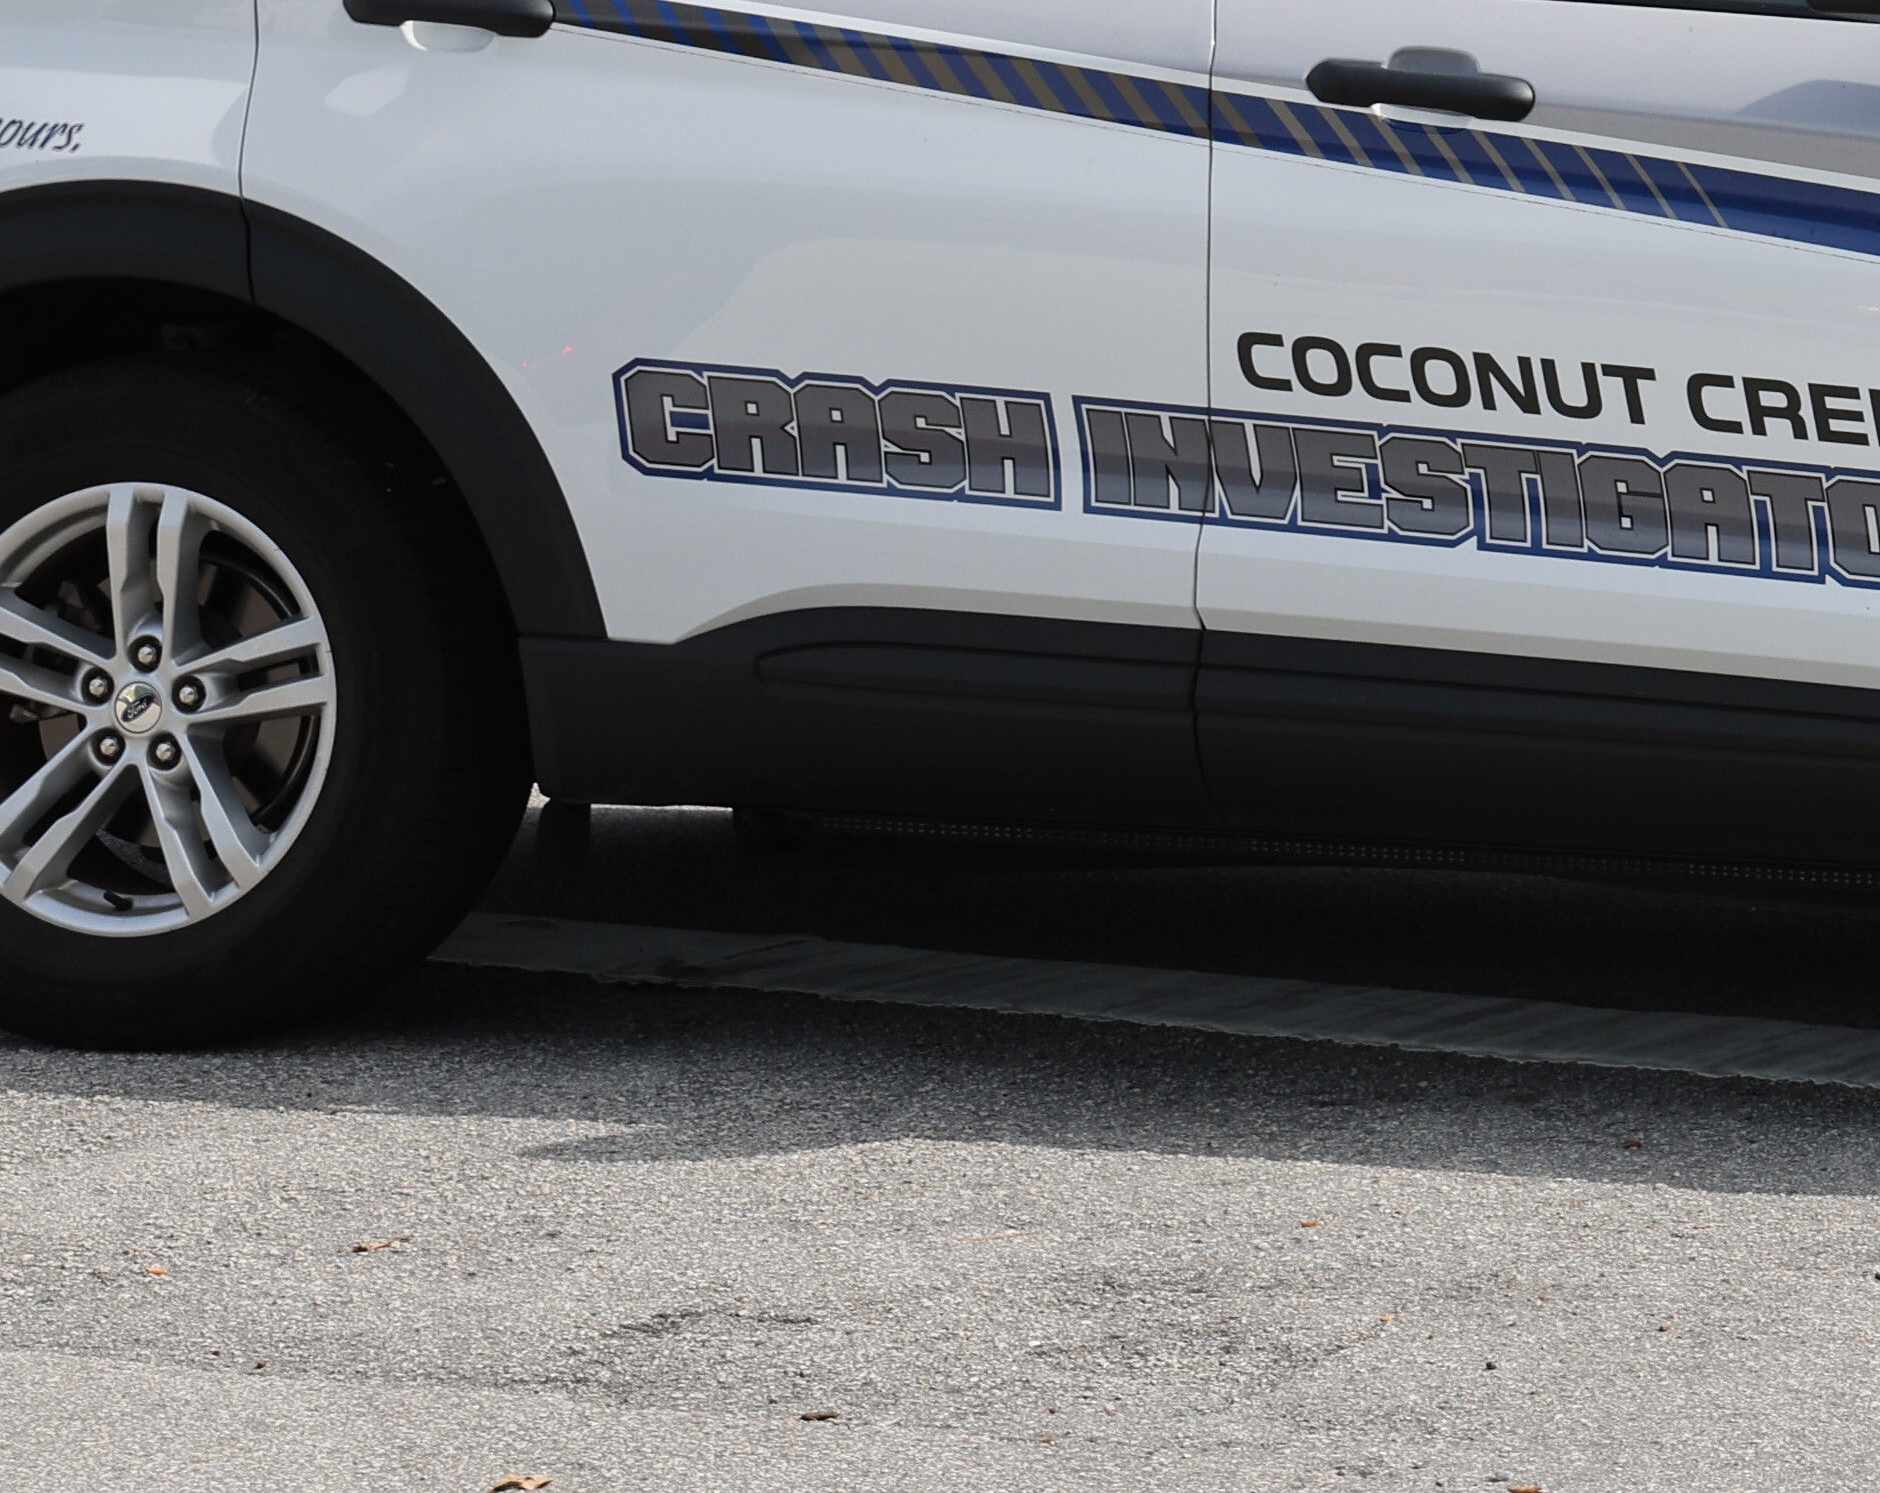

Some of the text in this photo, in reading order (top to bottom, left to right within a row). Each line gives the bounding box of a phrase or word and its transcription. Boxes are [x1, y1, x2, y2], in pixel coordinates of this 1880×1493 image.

[0, 118, 84, 153] ours,
[1236, 331, 1656, 427] COCONUT
[612, 358, 1062, 511] CRASH
